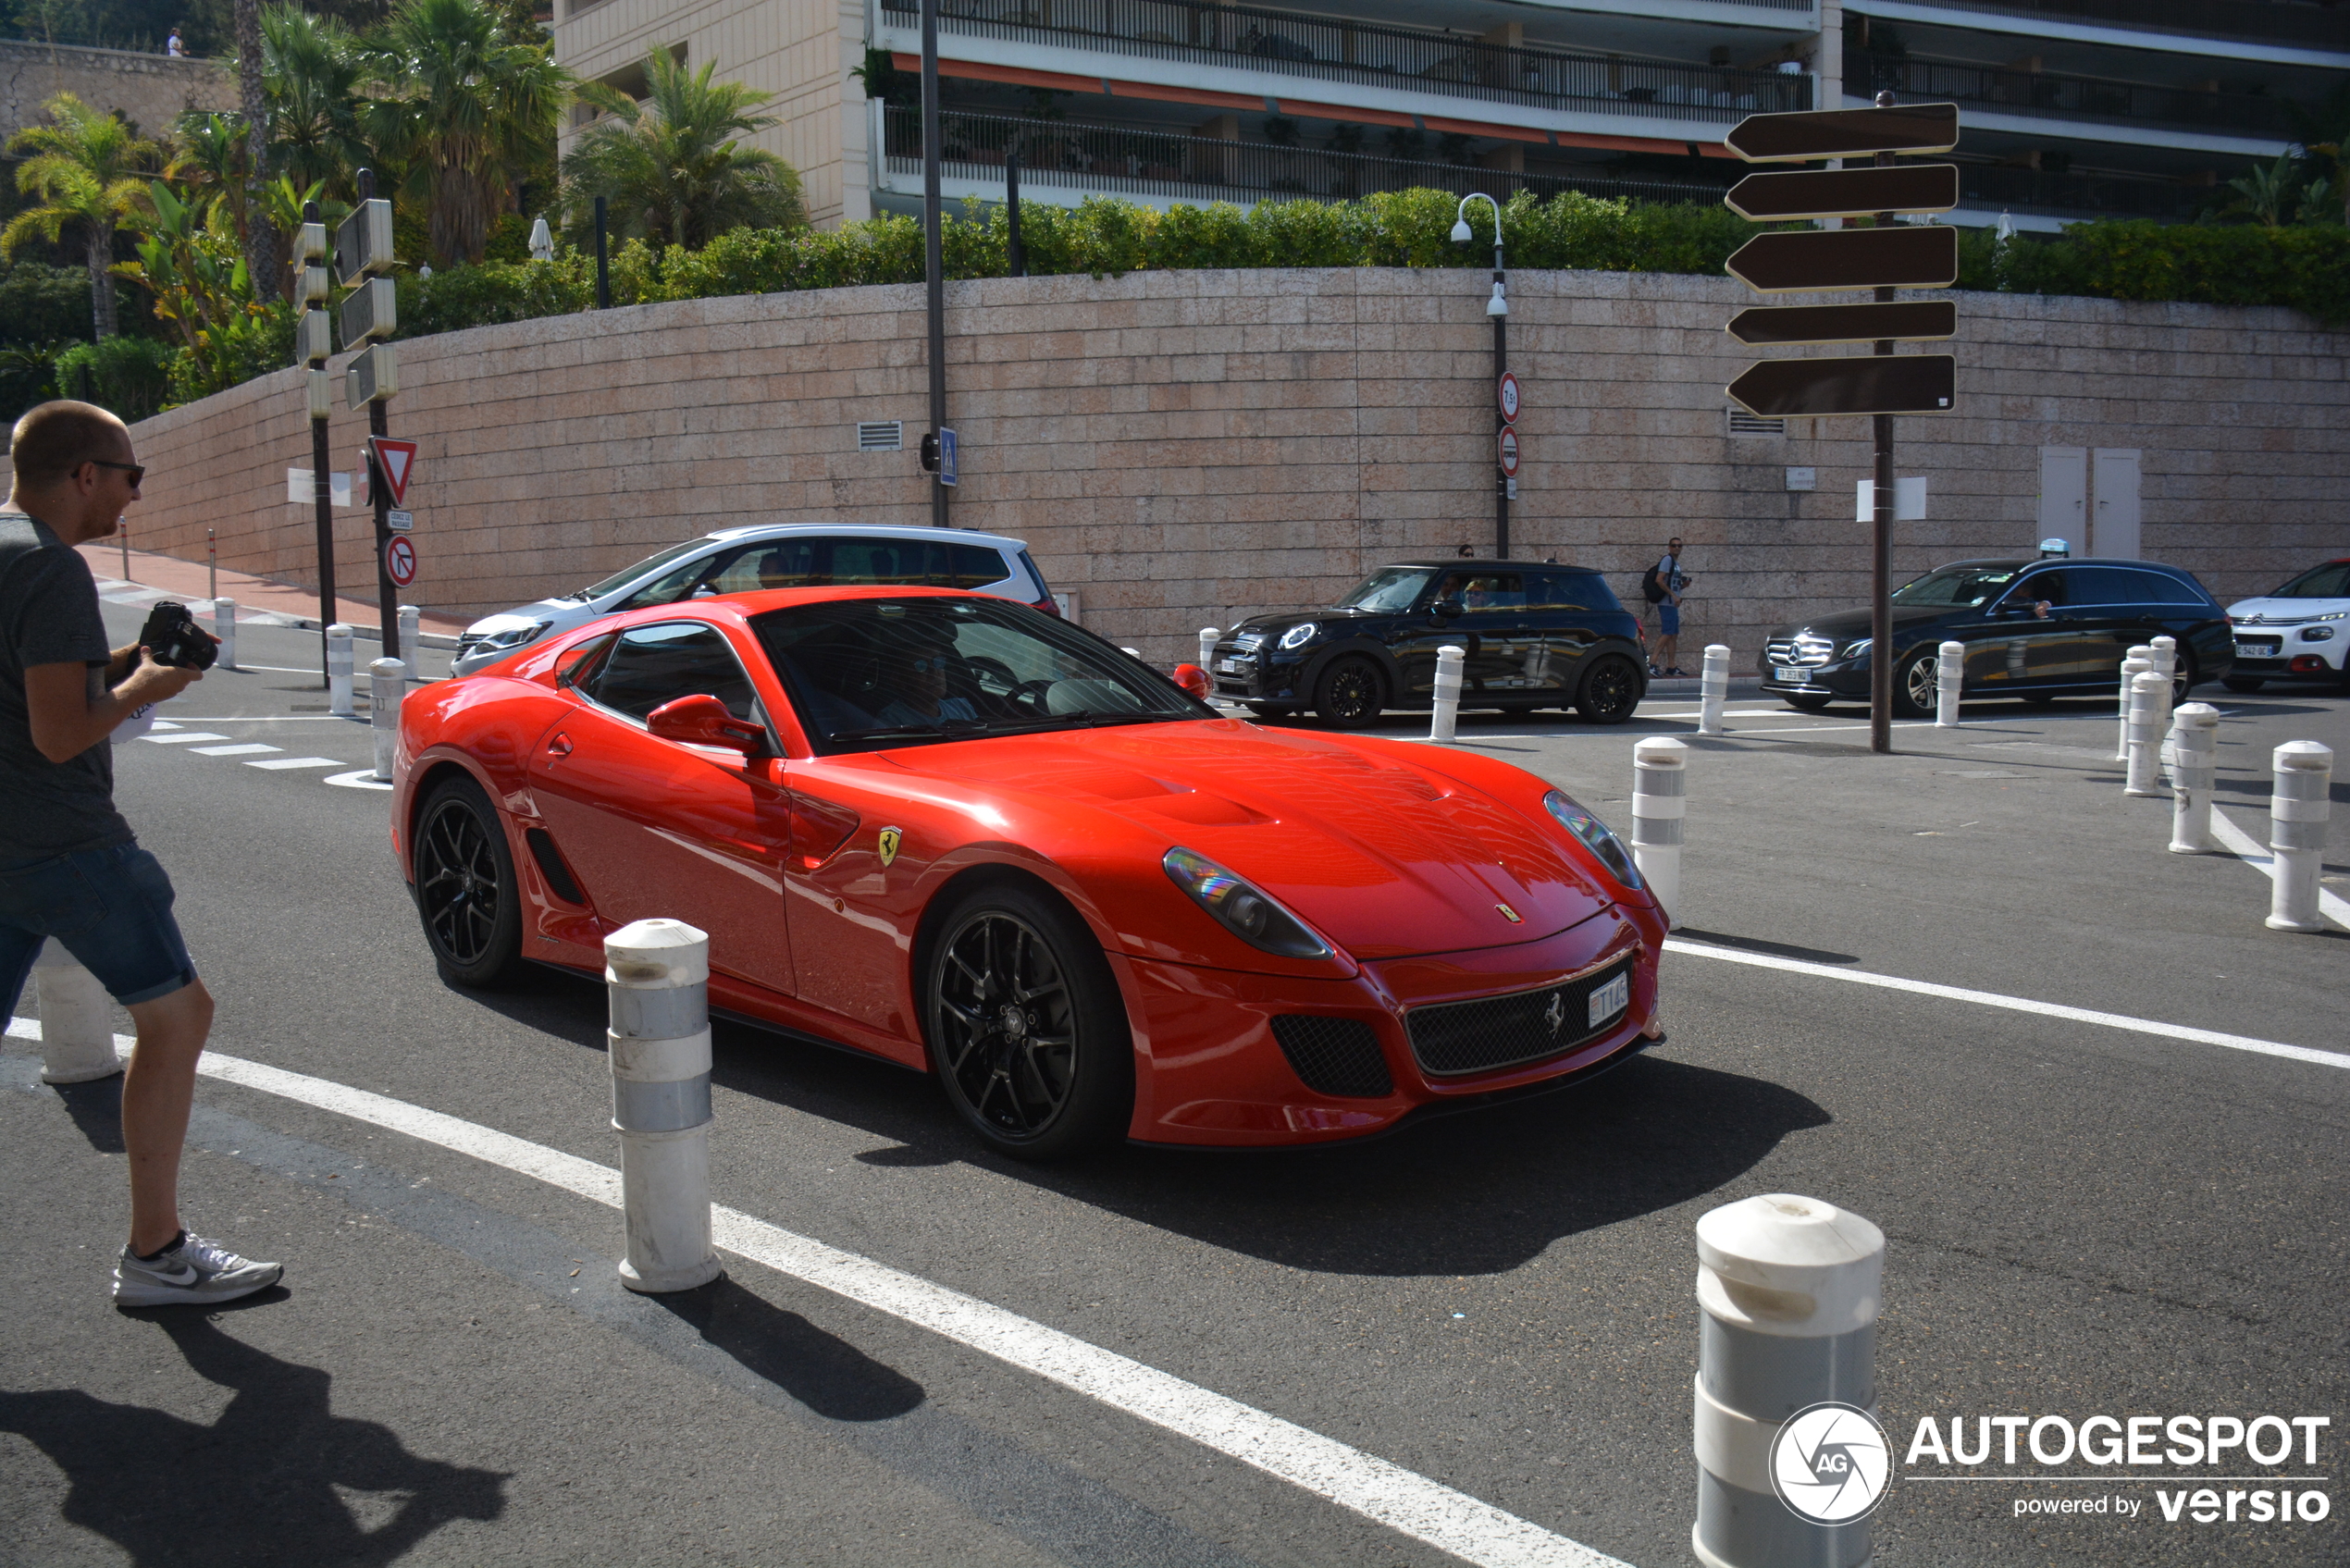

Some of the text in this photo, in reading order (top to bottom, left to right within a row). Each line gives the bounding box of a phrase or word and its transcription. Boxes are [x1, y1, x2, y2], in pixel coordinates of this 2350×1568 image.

[390, 512, 404, 520] CÉDEZ
[391, 520, 411, 528] PASSAGE
[1601, 979, 1626, 1017] T145
